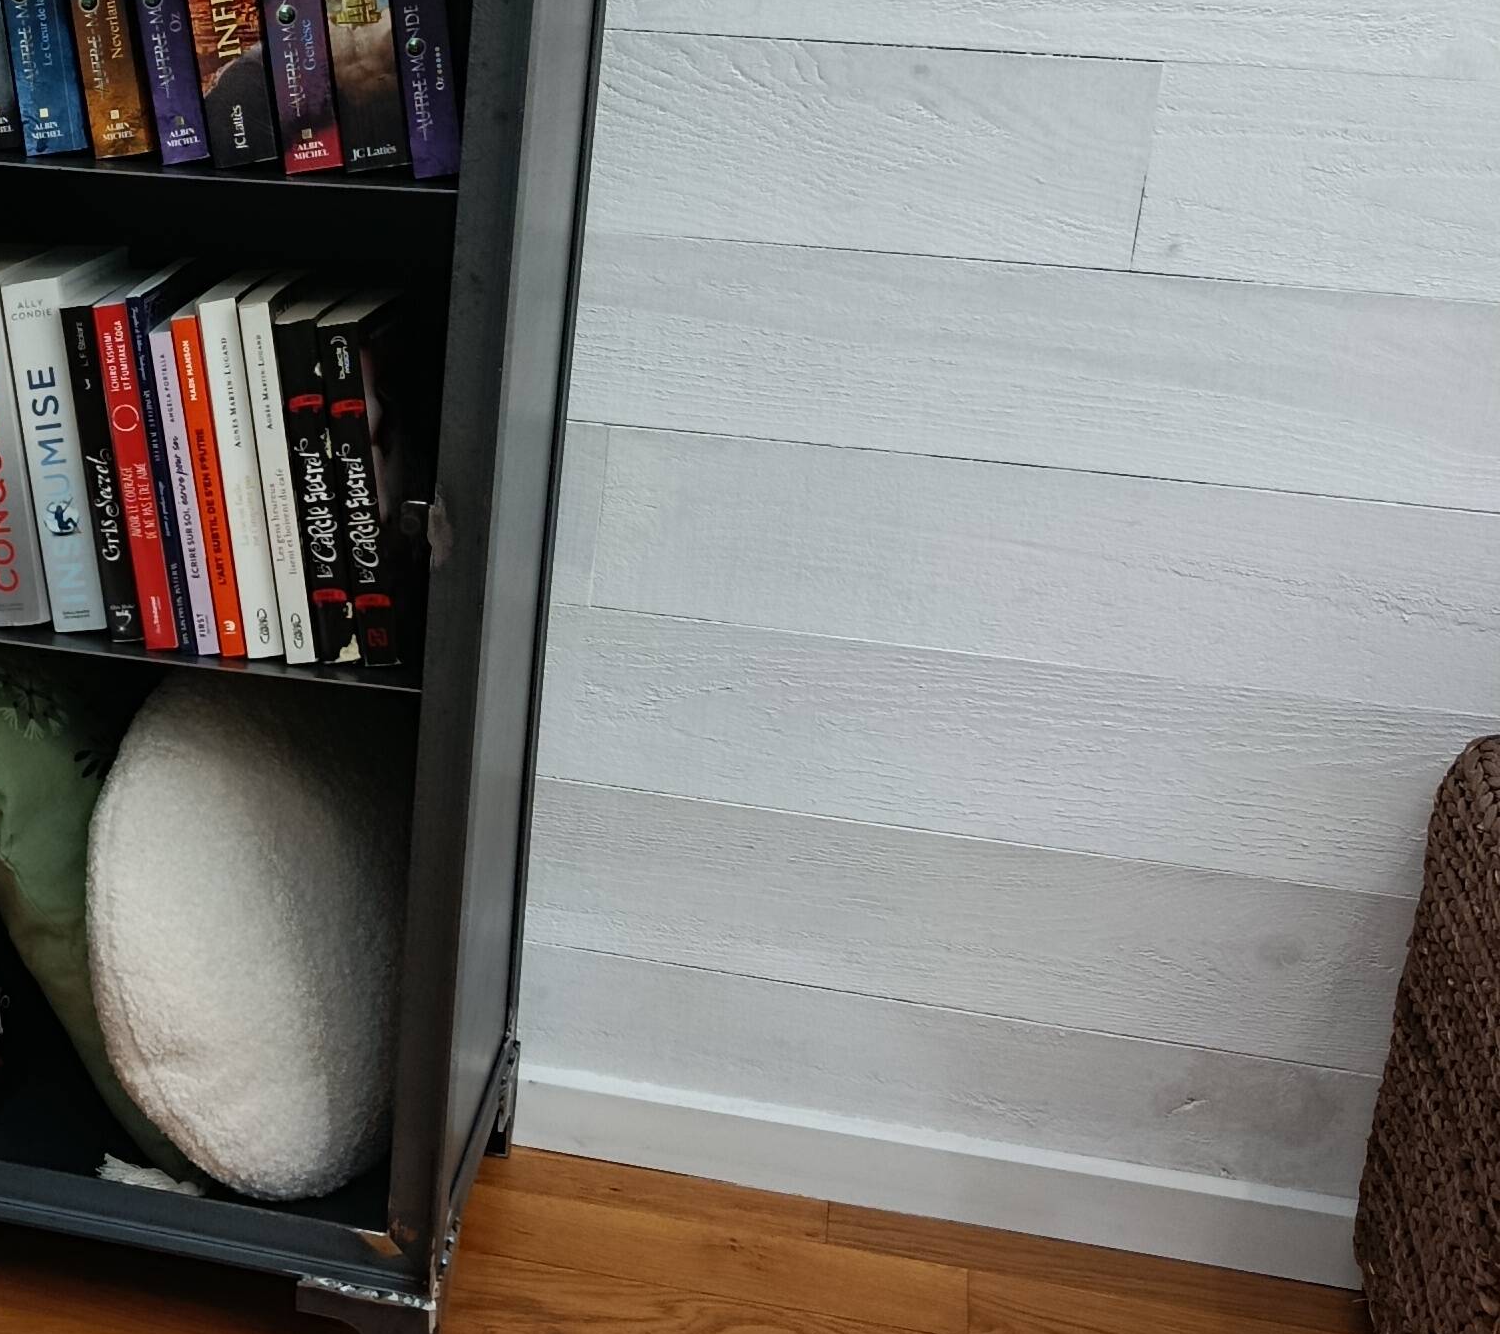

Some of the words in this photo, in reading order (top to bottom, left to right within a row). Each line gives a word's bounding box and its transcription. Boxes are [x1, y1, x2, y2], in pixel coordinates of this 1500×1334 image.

[169, 11, 182, 33] Oz
[11, 308, 53, 321] CONDIE
[17, 298, 43, 309] ALLY
[113, 320, 124, 343] KOGA
[182, 340, 193, 377] MANSON
[108, 365, 121, 392] ICHIRO
[159, 354, 171, 391] PORTELLA
[188, 378, 198, 402] MARK
[165, 394, 176, 423] ANGELA
[203, 473, 214, 498] S'EN
[206, 501, 218, 515] DE
[184, 527, 196, 547] SUR
[208, 517, 222, 556] SUBTIL
[187, 547, 200, 579] ÉCRIRE
[213, 557, 227, 585] L'ART
[195, 613, 207, 638] FIRST
